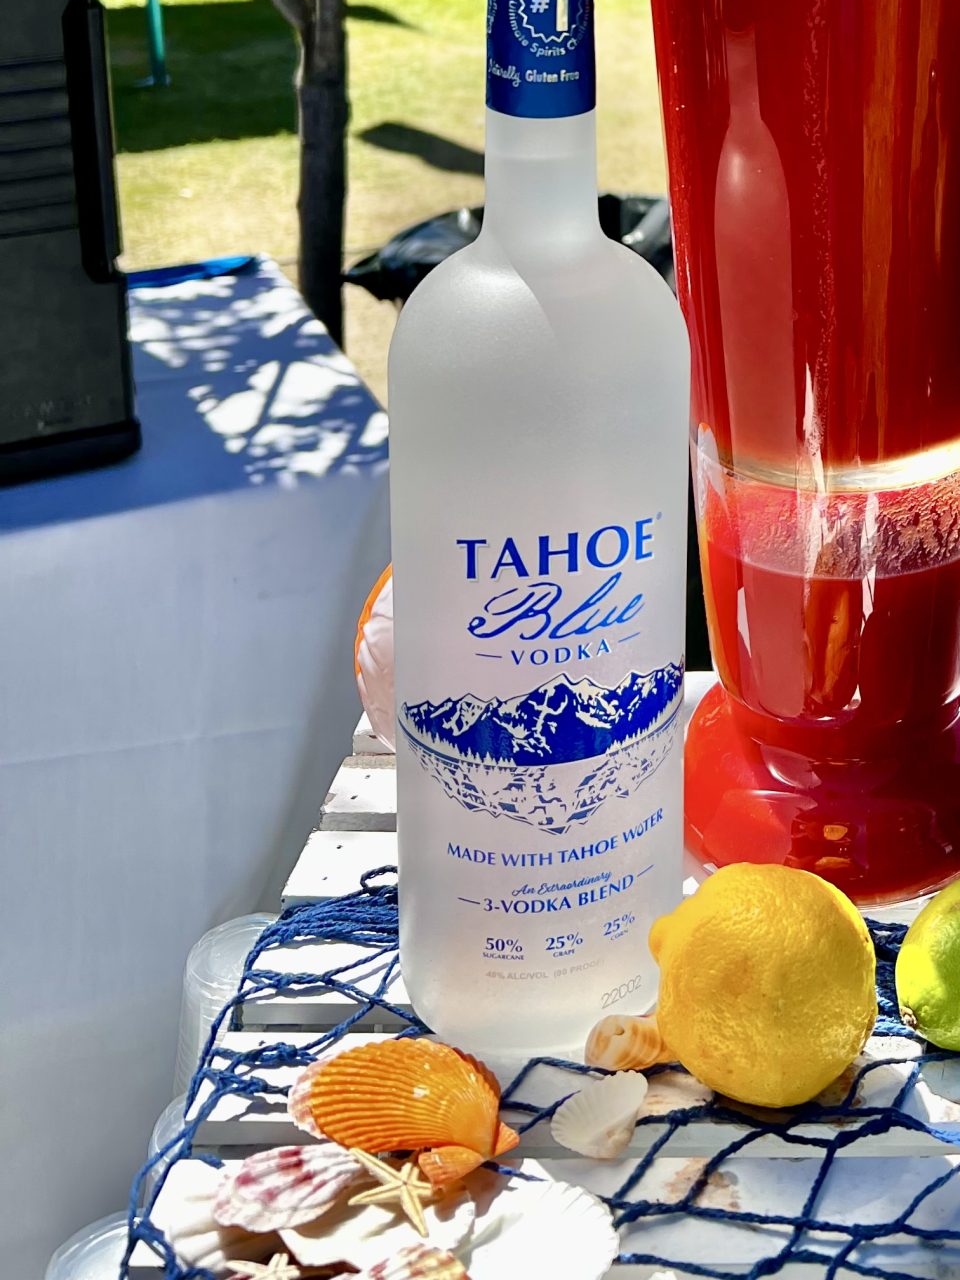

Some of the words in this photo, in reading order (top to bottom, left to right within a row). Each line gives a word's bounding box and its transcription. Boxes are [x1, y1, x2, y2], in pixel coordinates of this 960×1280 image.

[530, 42, 566, 57] Spirits
[525, 69, 559, 83] Gluten
[456, 517, 653, 579] TAHOE
[467, 571, 645, 640] Blue
[511, 638, 610, 666] VODKA
[447, 842, 496, 866] MADE
[502, 852, 553, 867] WITH
[558, 835, 618, 863] TAHOE
[483, 895, 571, 914] 3-VODKA
[578, 874, 634, 906] BLEND
[512, 883, 535, 896] An
[537, 870, 613, 895] Extraordinary
[603, 911, 635, 936] 25%
[485, 937, 523, 953] 50%
[545, 931, 584, 951] 25%
